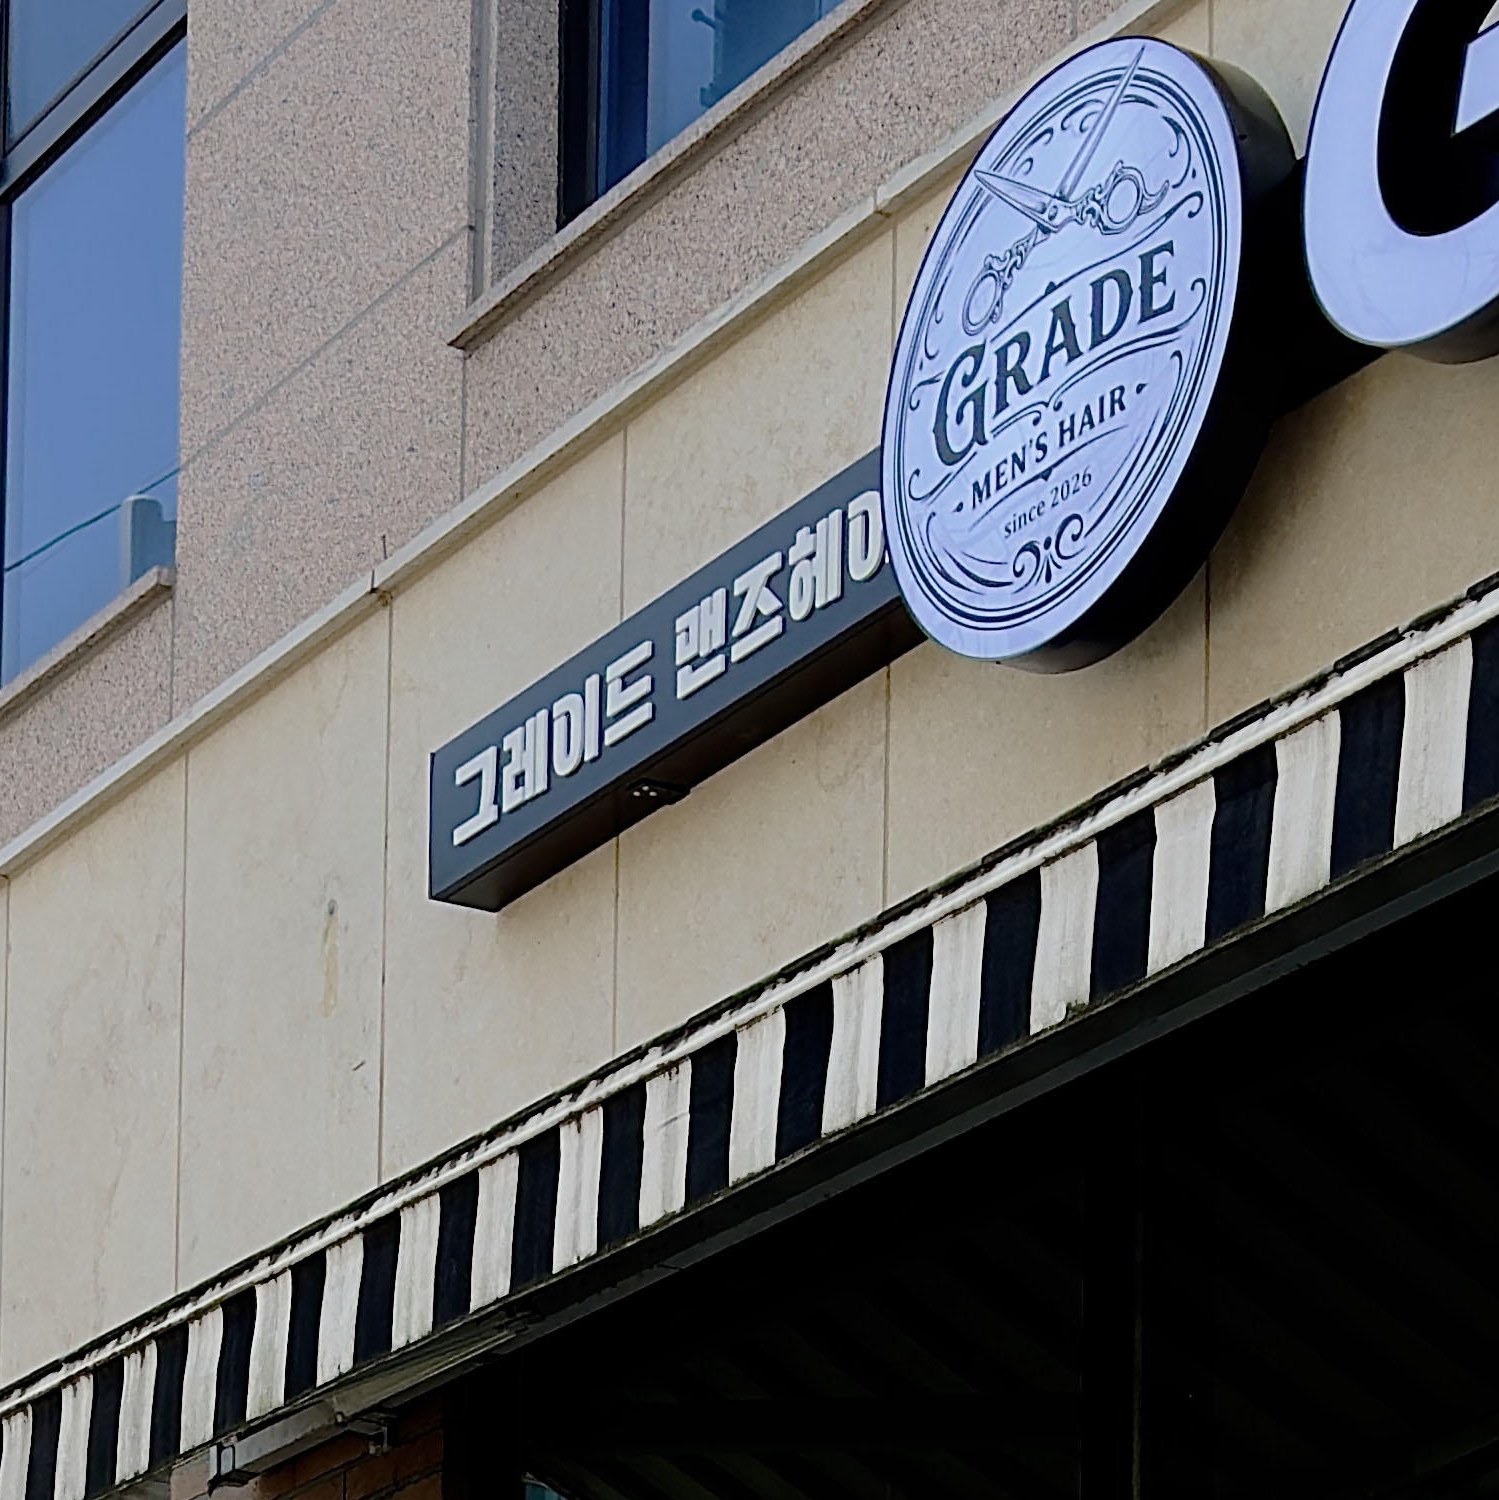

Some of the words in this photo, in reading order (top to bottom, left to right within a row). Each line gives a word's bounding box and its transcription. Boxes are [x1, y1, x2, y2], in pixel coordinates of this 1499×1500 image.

[933, 242, 1176, 467] GRADE
[971, 432, 1049, 510] MEN'S
[1057, 384, 1126, 455] HAIR
[1003, 497, 1045, 539] since
[1050, 467, 1093, 508] 2026
[452, 640, 653, 846] 그레이드
